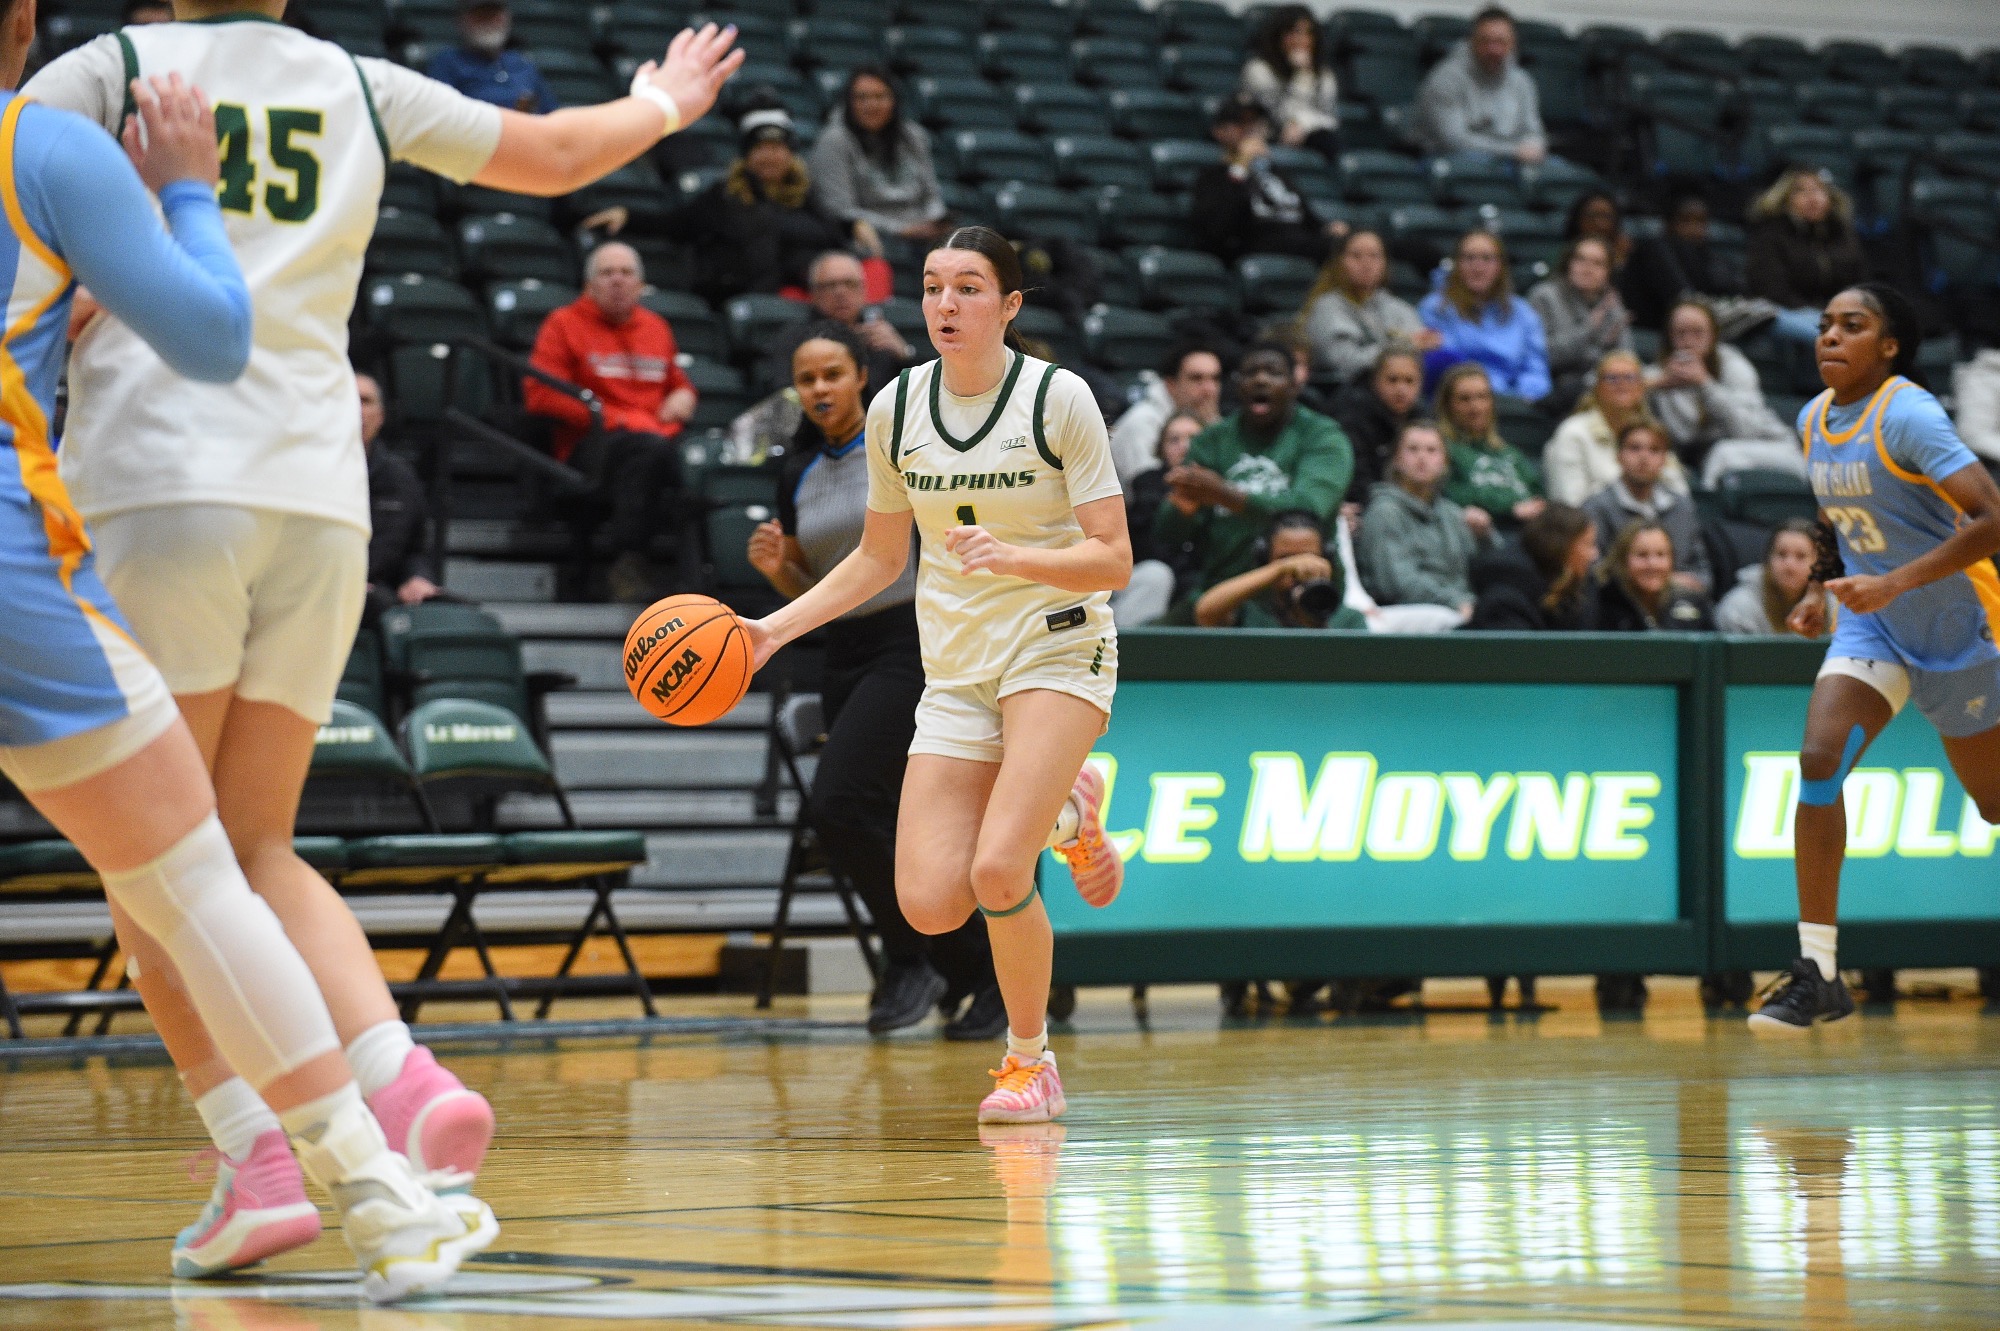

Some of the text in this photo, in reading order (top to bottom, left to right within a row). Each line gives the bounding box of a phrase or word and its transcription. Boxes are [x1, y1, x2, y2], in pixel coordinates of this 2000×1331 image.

[210, 102, 326, 226] 45
[1001, 436, 1026, 450] NEC
[903, 469, 1037, 491] DOLPHINS
[1823, 507, 1887, 553] 23
[625, 617, 685, 681] Wilson
[650, 647, 703, 704] NCAA
[1238, 751, 1662, 862] MOYNE
[1733, 750, 2000, 858] DOL
